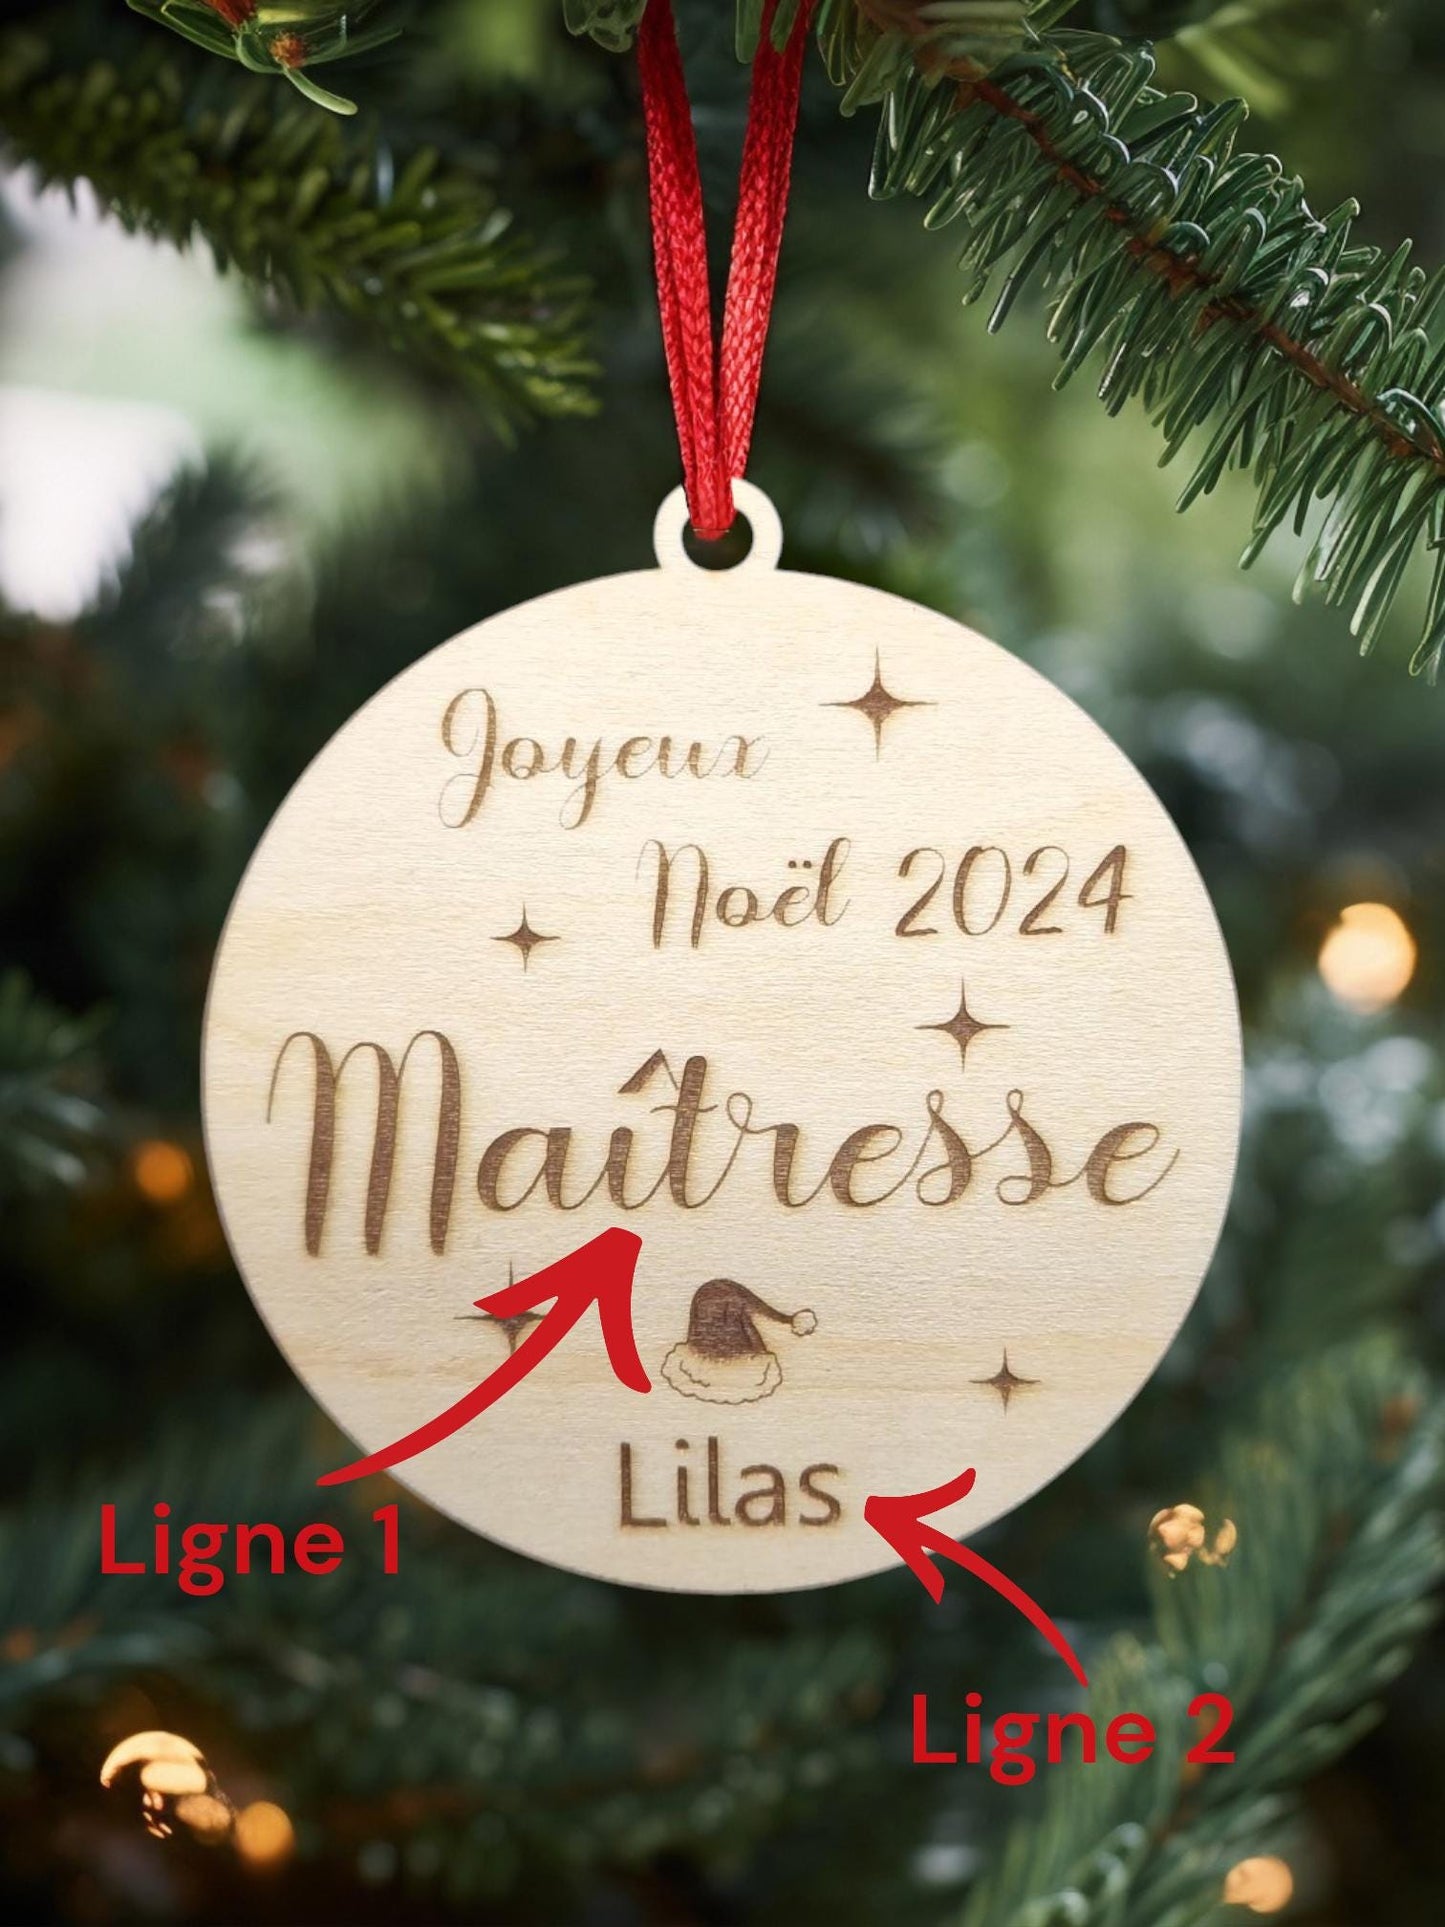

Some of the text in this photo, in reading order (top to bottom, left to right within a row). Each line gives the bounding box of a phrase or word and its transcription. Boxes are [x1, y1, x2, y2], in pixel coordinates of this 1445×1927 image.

[438, 687, 771, 830] Joyeux
[635, 836, 1134, 951] Noël 2024
[266, 1029, 1181, 1258] Maîtresse
[618, 1436, 844, 1531] Lilas
